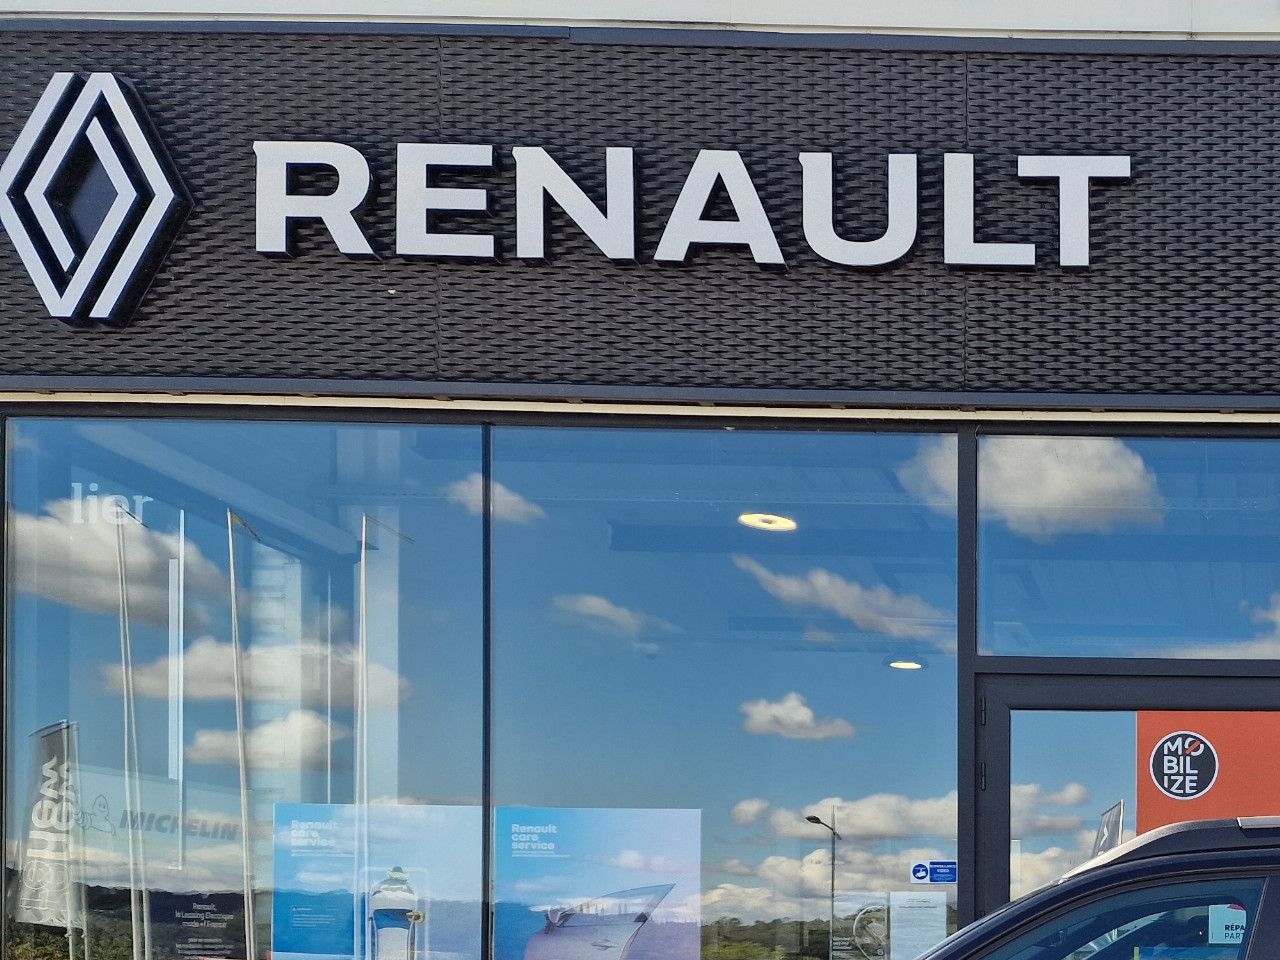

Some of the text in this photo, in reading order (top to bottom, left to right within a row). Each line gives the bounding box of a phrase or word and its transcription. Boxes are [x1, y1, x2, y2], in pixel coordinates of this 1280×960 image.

[253, 140, 1131, 268] RENAULT
[119, 809, 239, 841] MICHELIN
[511, 823, 558, 833] Renault
[511, 833, 539, 842] care
[511, 841, 555, 850] service
